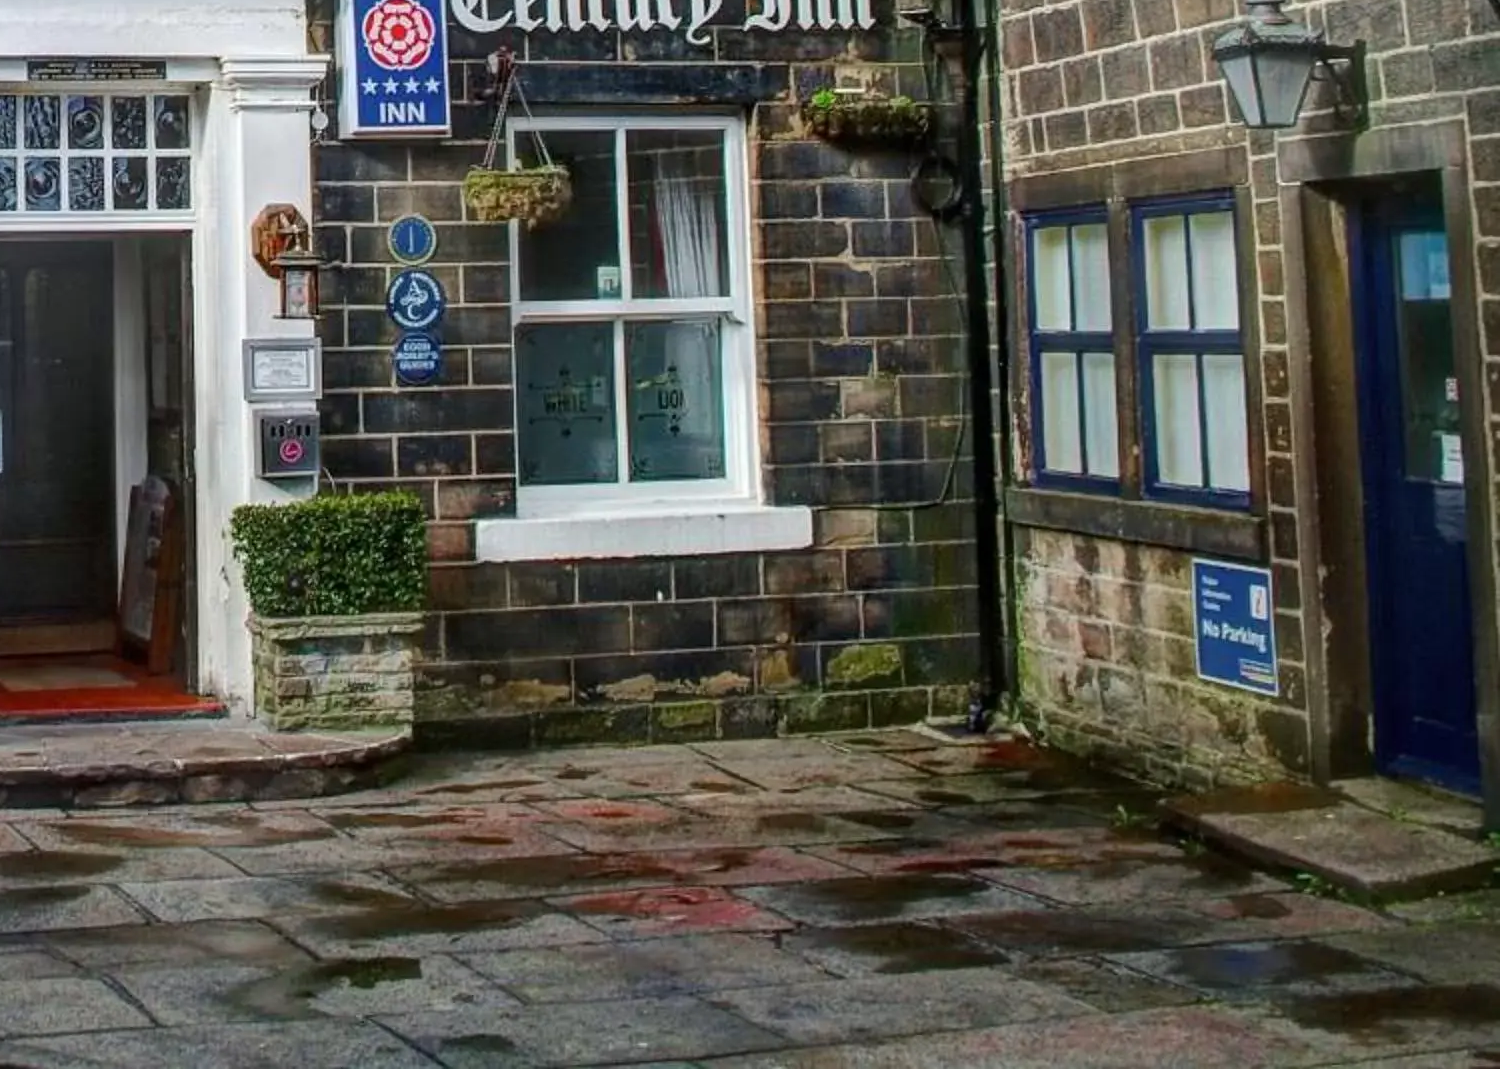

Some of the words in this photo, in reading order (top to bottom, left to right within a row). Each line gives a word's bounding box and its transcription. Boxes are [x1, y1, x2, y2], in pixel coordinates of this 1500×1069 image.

[379, 101, 426, 123] INN
[1202, 619, 1220, 639] No
[1222, 623, 1267, 653] Parking
